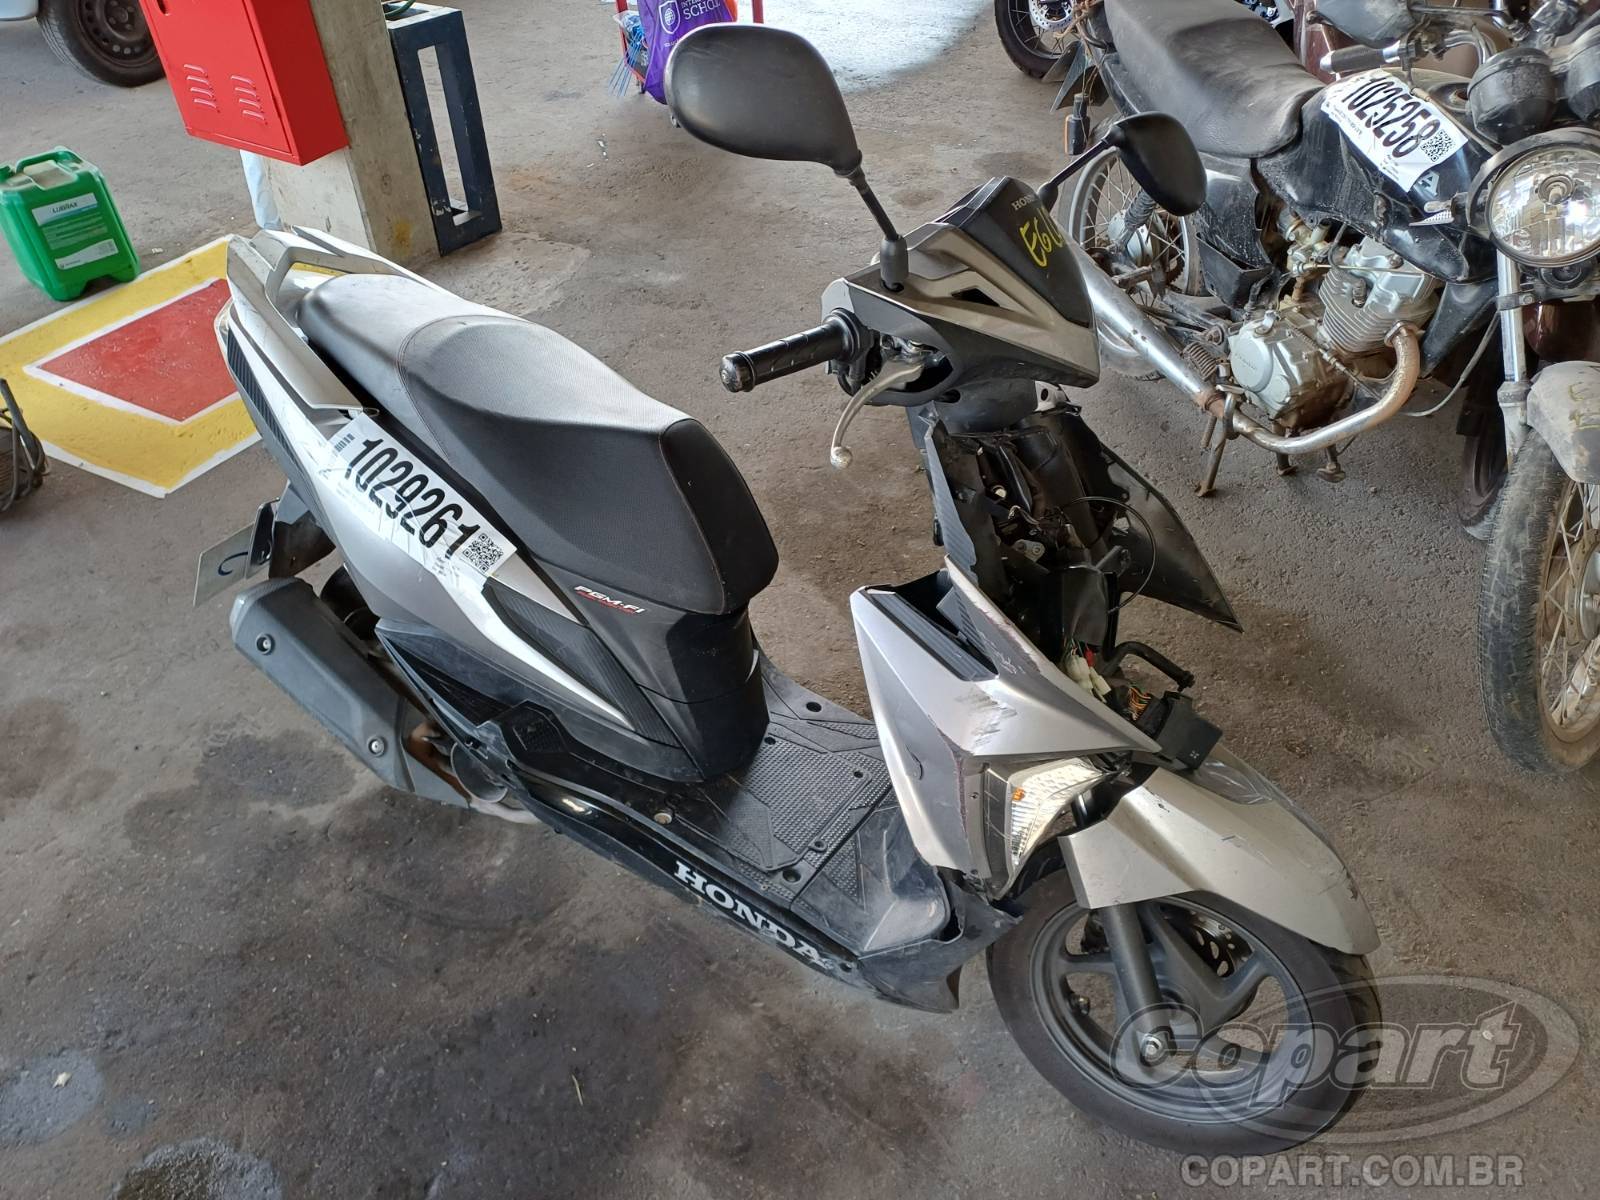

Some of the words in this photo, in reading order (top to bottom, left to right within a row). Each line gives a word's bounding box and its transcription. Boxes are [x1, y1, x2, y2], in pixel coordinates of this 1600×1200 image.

[1342, 77, 1441, 158] 1025258
[344, 438, 481, 560] 1029261
[674, 861, 834, 970] HONDA
